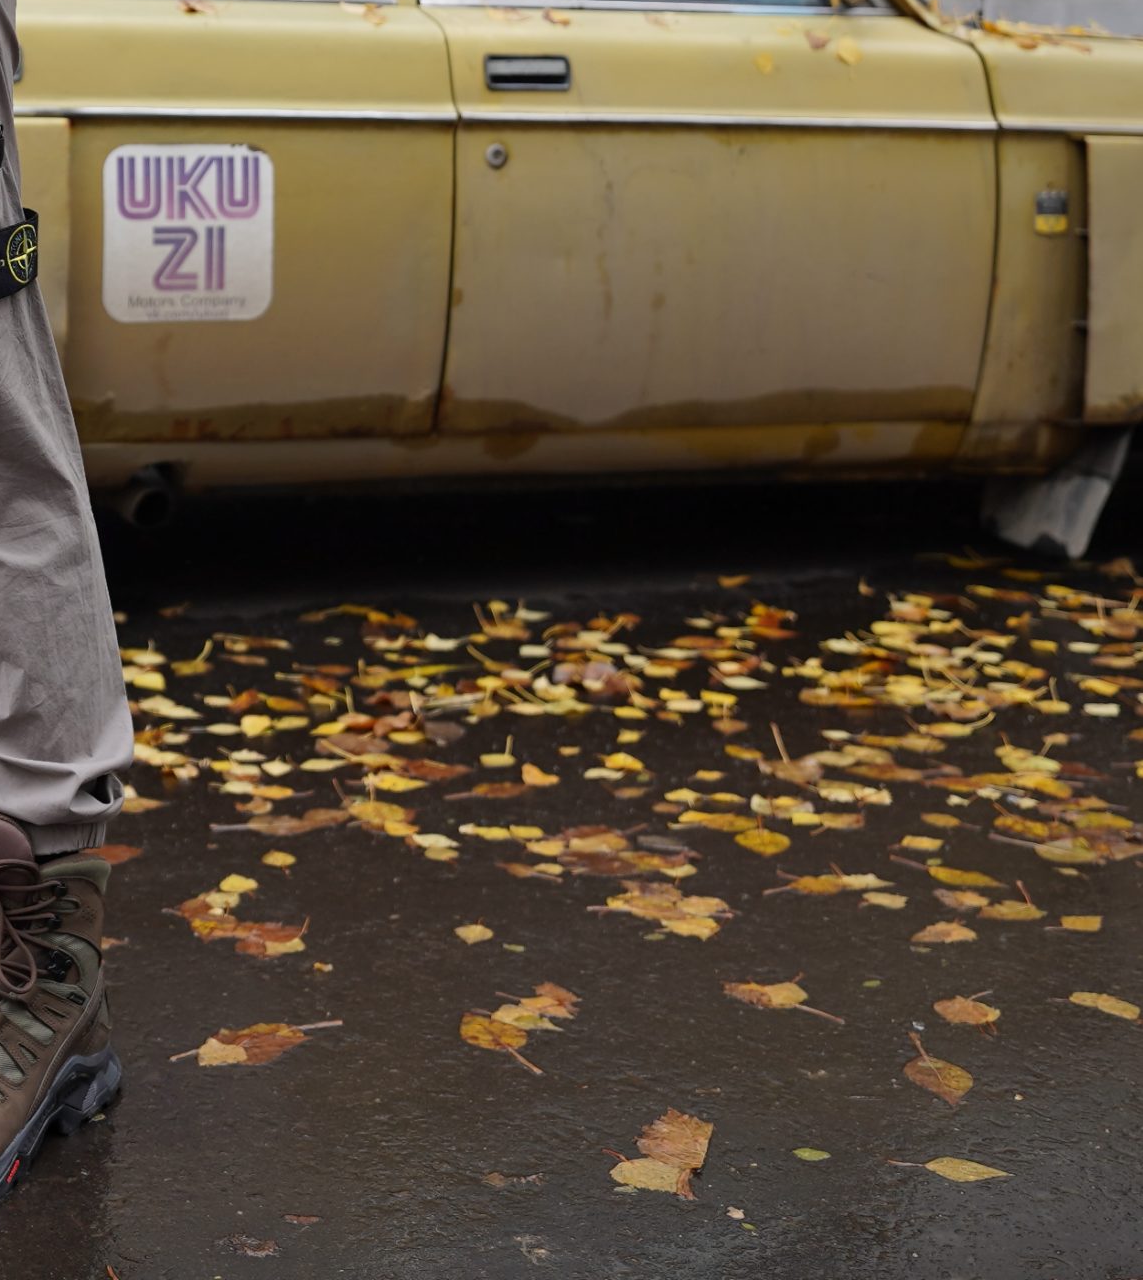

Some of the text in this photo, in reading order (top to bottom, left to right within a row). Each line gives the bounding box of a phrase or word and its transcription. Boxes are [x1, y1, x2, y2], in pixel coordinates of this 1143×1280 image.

[117, 156, 259, 220] UKU
[153, 226, 225, 291] ZI
[127, 294, 246, 309] Motors Company
